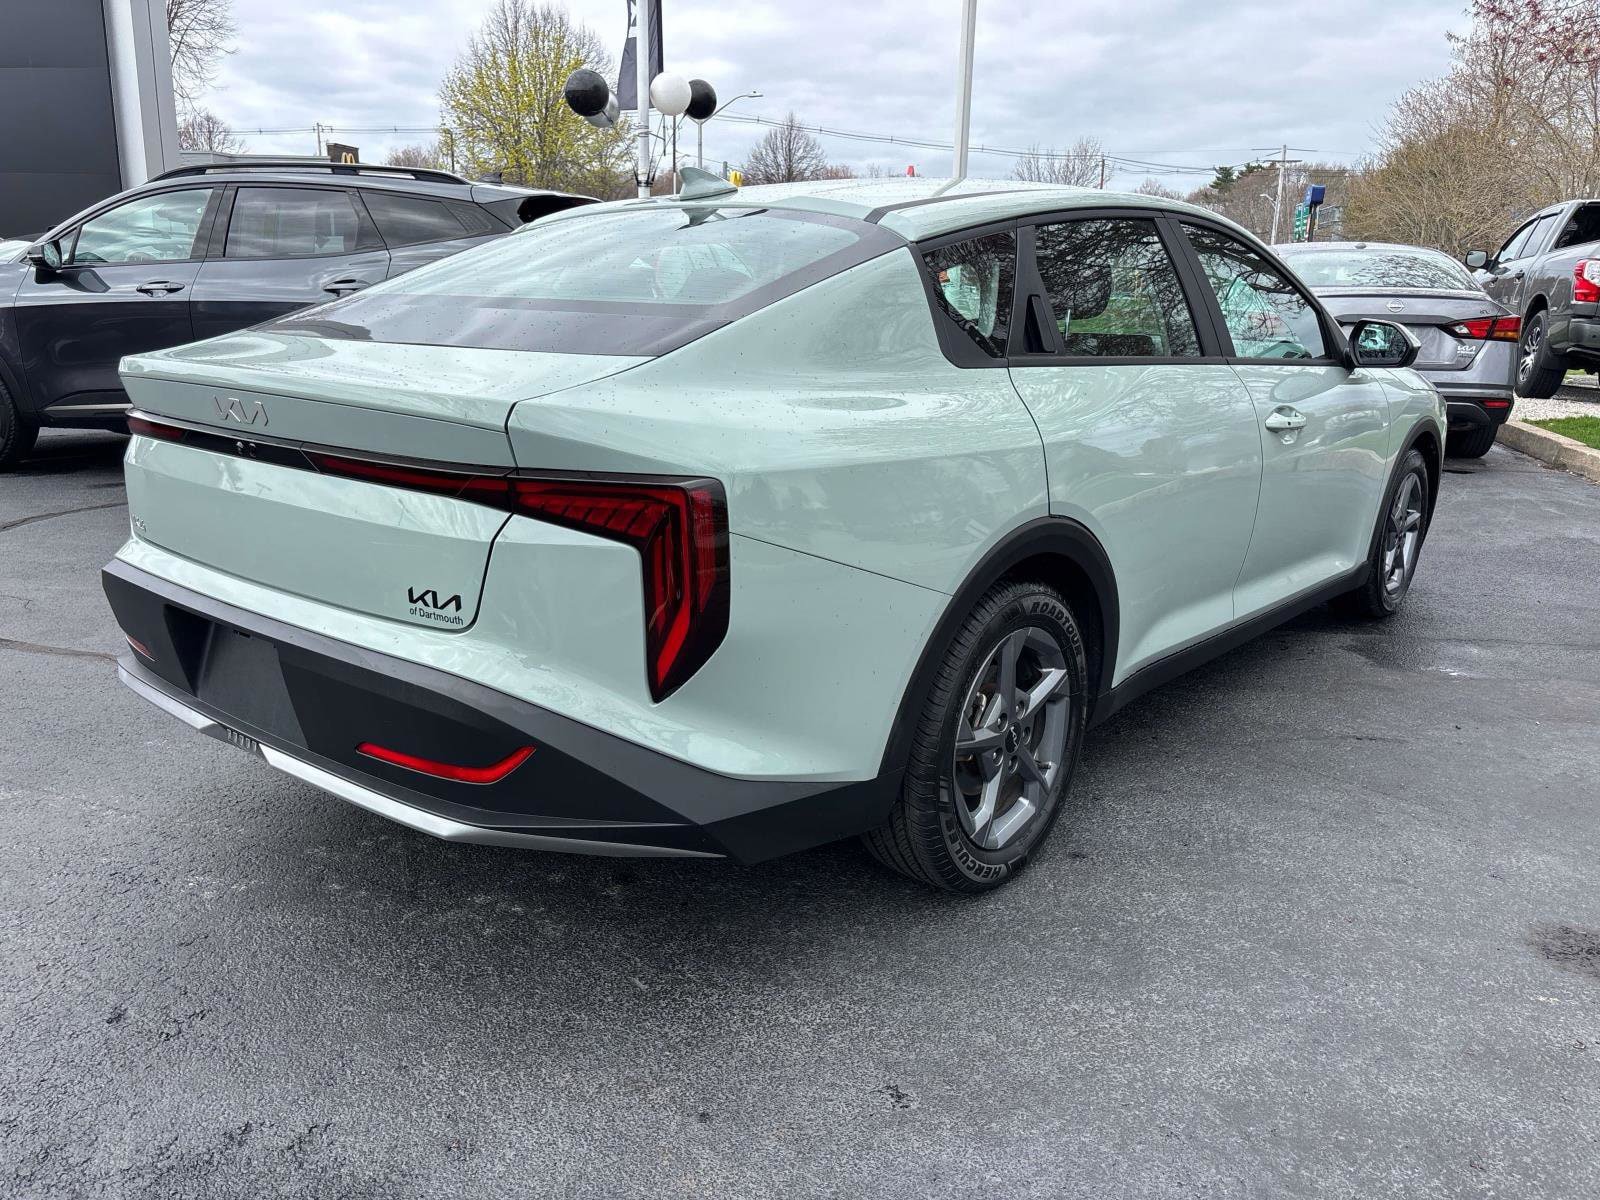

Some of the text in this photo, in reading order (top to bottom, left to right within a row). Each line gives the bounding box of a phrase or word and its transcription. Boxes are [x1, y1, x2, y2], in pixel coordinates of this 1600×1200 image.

[213, 395, 269, 427] KIA
[408, 586, 462, 612] KIA
[409, 606, 464, 626] of Dartmouth
[1029, 601, 1082, 656] ROADTOUR
[944, 817, 1003, 880] HERCULES
